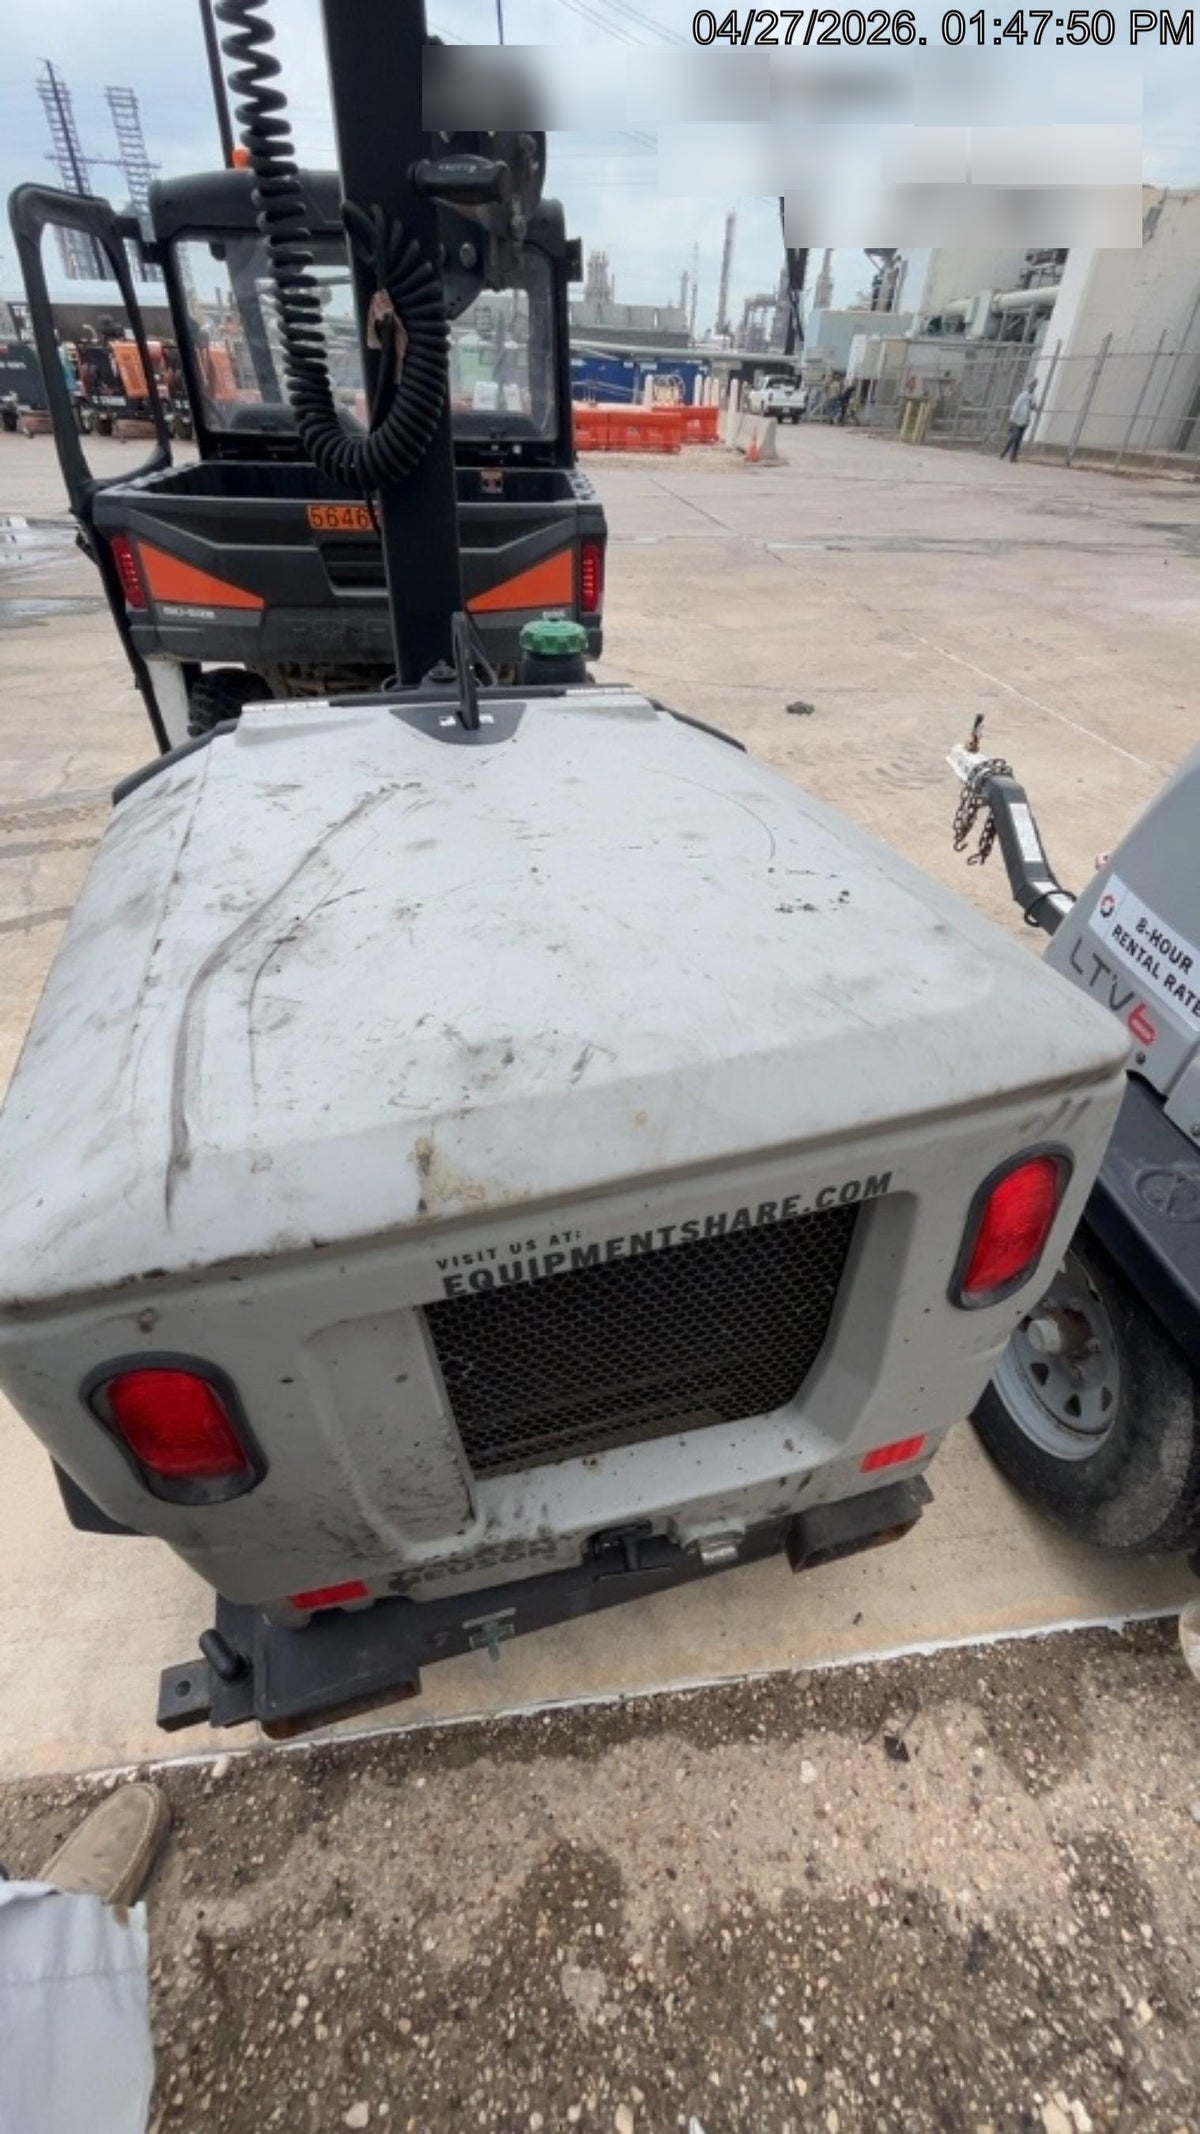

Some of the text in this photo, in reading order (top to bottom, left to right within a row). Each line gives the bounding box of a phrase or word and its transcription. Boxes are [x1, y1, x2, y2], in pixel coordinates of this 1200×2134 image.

[1111, 923, 1160, 980] RENTAL
[1135, 916, 1194, 976] 8-HOUR
[435, 1229, 582, 1271] VISIT US AT:
[442, 1170, 894, 1299] EQUIPMENTSHARE.COM
